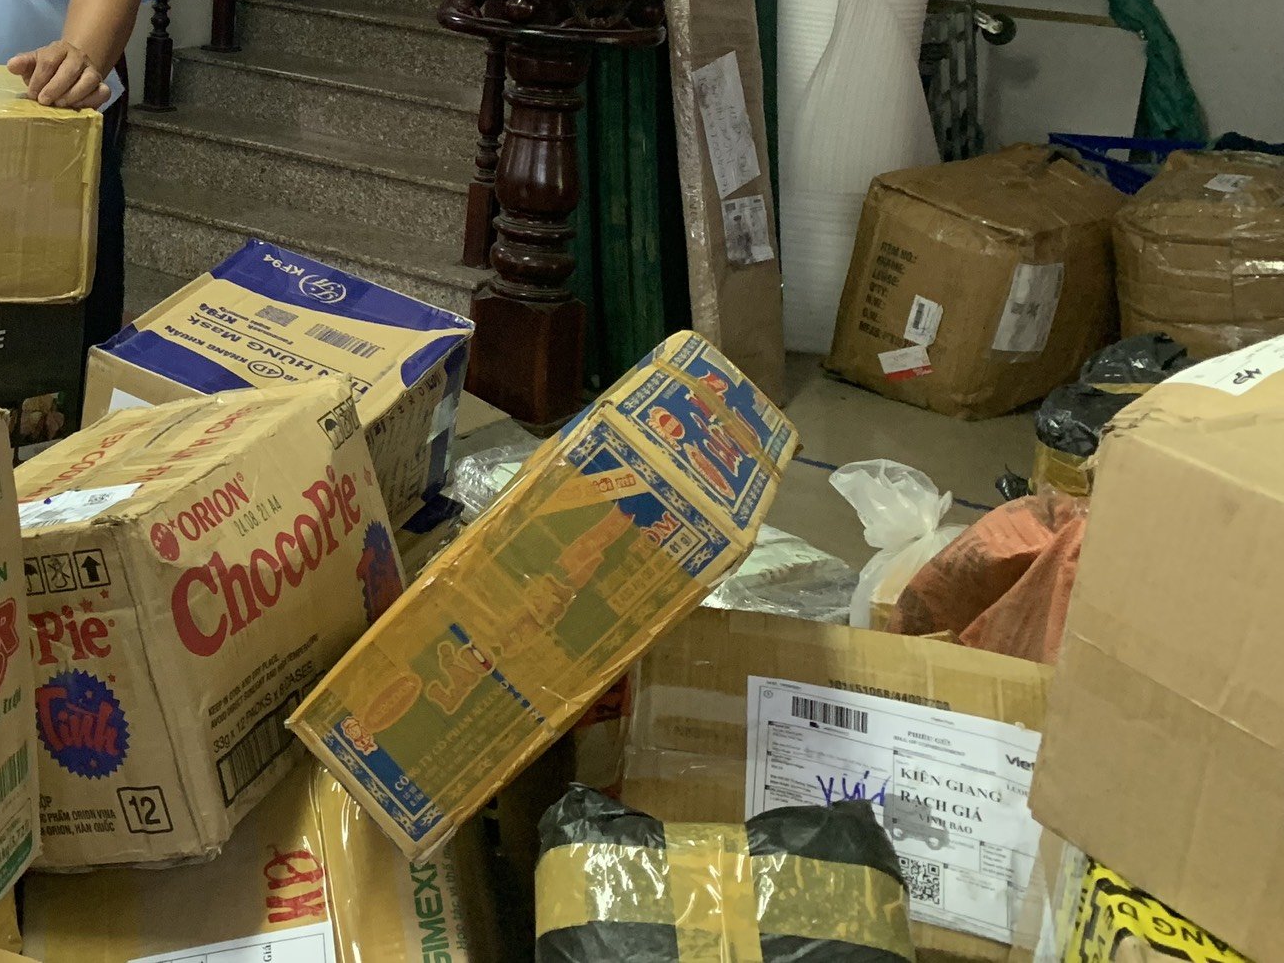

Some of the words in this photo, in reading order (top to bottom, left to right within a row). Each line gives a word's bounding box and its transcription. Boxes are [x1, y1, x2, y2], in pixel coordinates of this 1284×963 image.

[263, 254, 305, 276] KF94
[199, 302, 238, 325] KF94
[187, 315, 242, 343] Mask
[251, 362, 281, 377] 4D
[177, 477, 250, 541] ORION
[901, 766, 941, 788] KIÊN
[946, 778, 1003, 804] GIANG
[128, 795, 162, 825] 12
[900, 789, 950, 813] RẠCH
[951, 800, 984, 823] GIÁ
